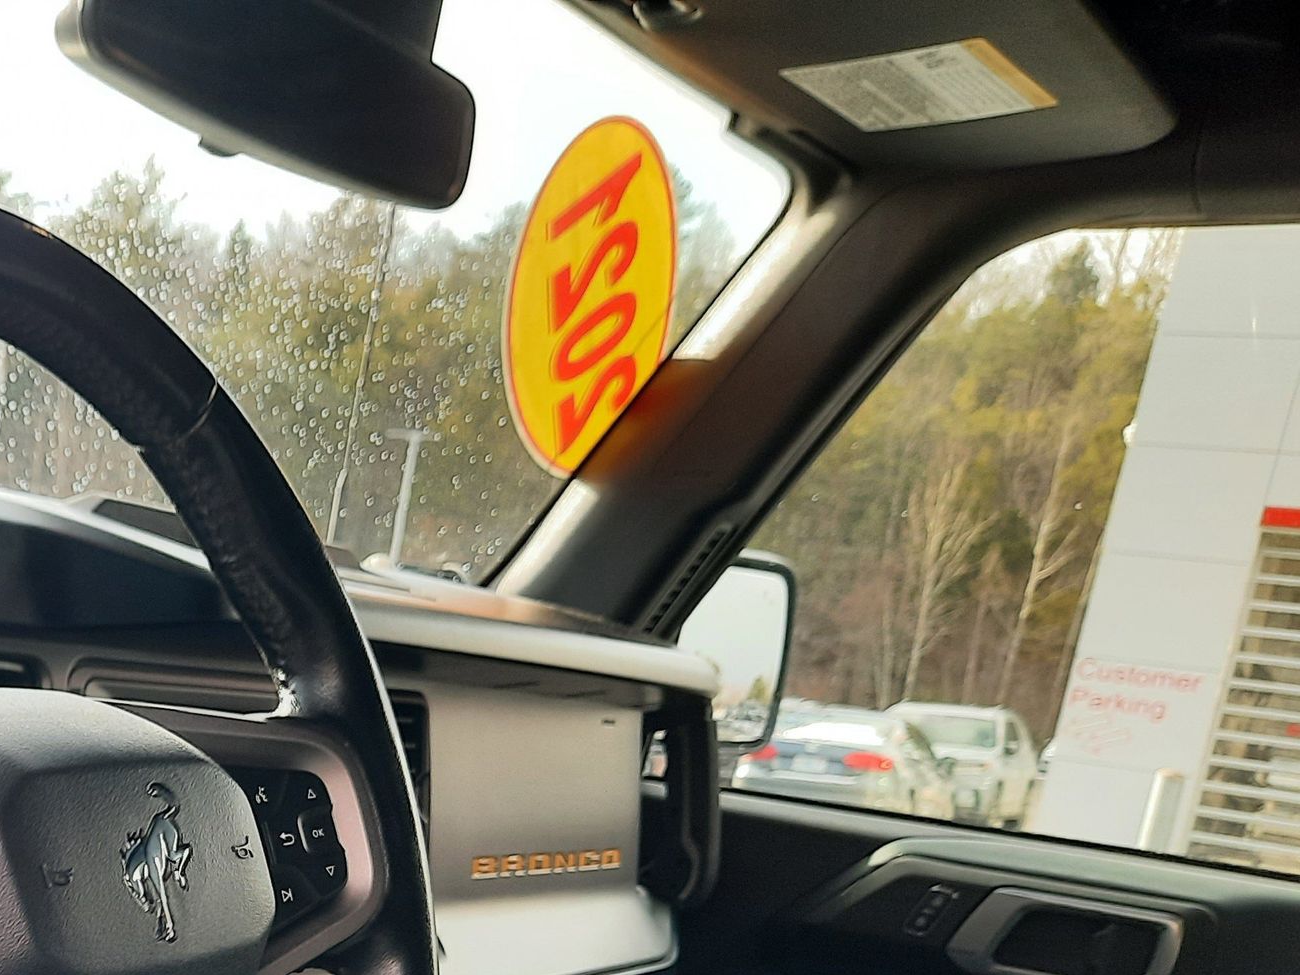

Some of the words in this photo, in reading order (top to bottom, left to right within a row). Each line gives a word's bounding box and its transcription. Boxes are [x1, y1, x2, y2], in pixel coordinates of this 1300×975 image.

[1076, 656, 1206, 692] Customer
[1068, 685, 1168, 724] Parking
[312, 828, 325, 839] OK
[471, 848, 621, 879] BRONCO
